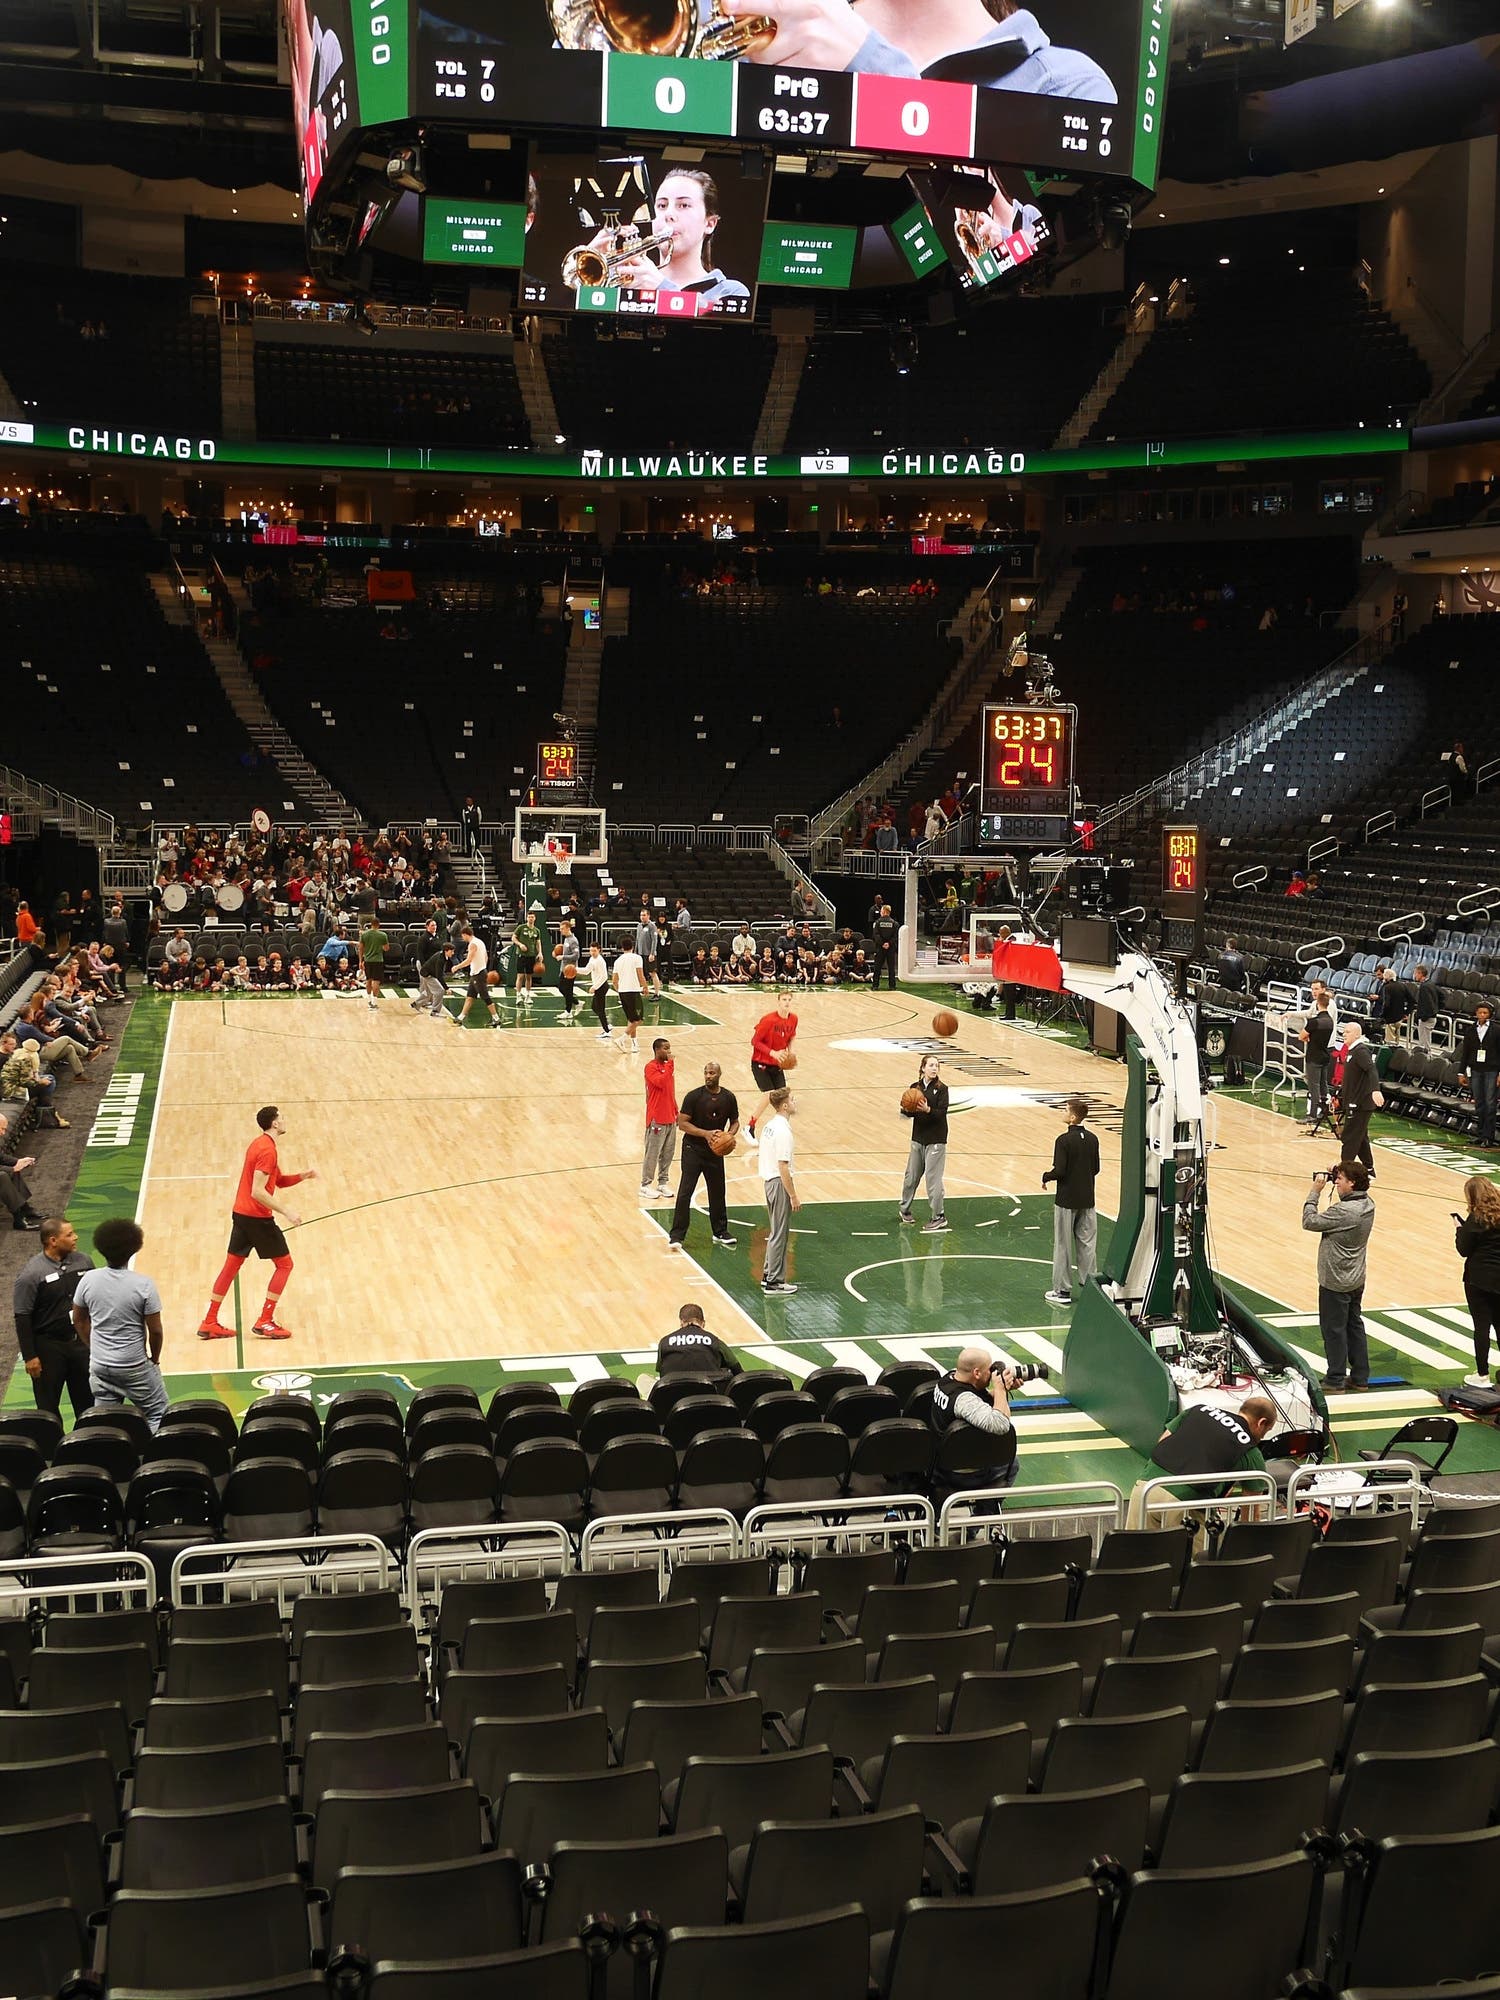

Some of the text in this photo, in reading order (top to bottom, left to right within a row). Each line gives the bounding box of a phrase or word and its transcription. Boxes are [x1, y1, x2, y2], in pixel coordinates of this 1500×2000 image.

[436, 60, 496, 80] TOL 7
[480, 83, 495, 102] 0
[655, 77, 686, 114] 0
[774, 75, 819, 98] PrG
[758, 107, 830, 135] 63:37
[901, 101, 930, 136] 0
[1063, 115, 1113, 136] TOL 7
[1099, 138, 1111, 157] 0
[446, 216, 502, 226] MILWAUKEE
[452, 244, 494, 253] CHICAGO
[781, 239, 833, 249] MILWAUKEE
[784, 265, 823, 275] CHICAGO
[591, 291, 606, 306] 0
[670, 297, 684, 311] 0
[0, 426, 216, 460] VS CHICAGO
[581, 452, 1025, 477] MILWAUKEE VS CHICAGO
[995, 715, 1060, 741] 63:37
[543, 746, 574, 759] 63:37
[546, 758, 570, 777] 24
[1001, 743, 1053, 785] 24
[1170, 836, 1196, 857] 63:37
[1174, 859, 1191, 887] 24
[668, 1334, 712, 1346] PHOTO
[1200, 1405, 1251, 1444] PHOTO
